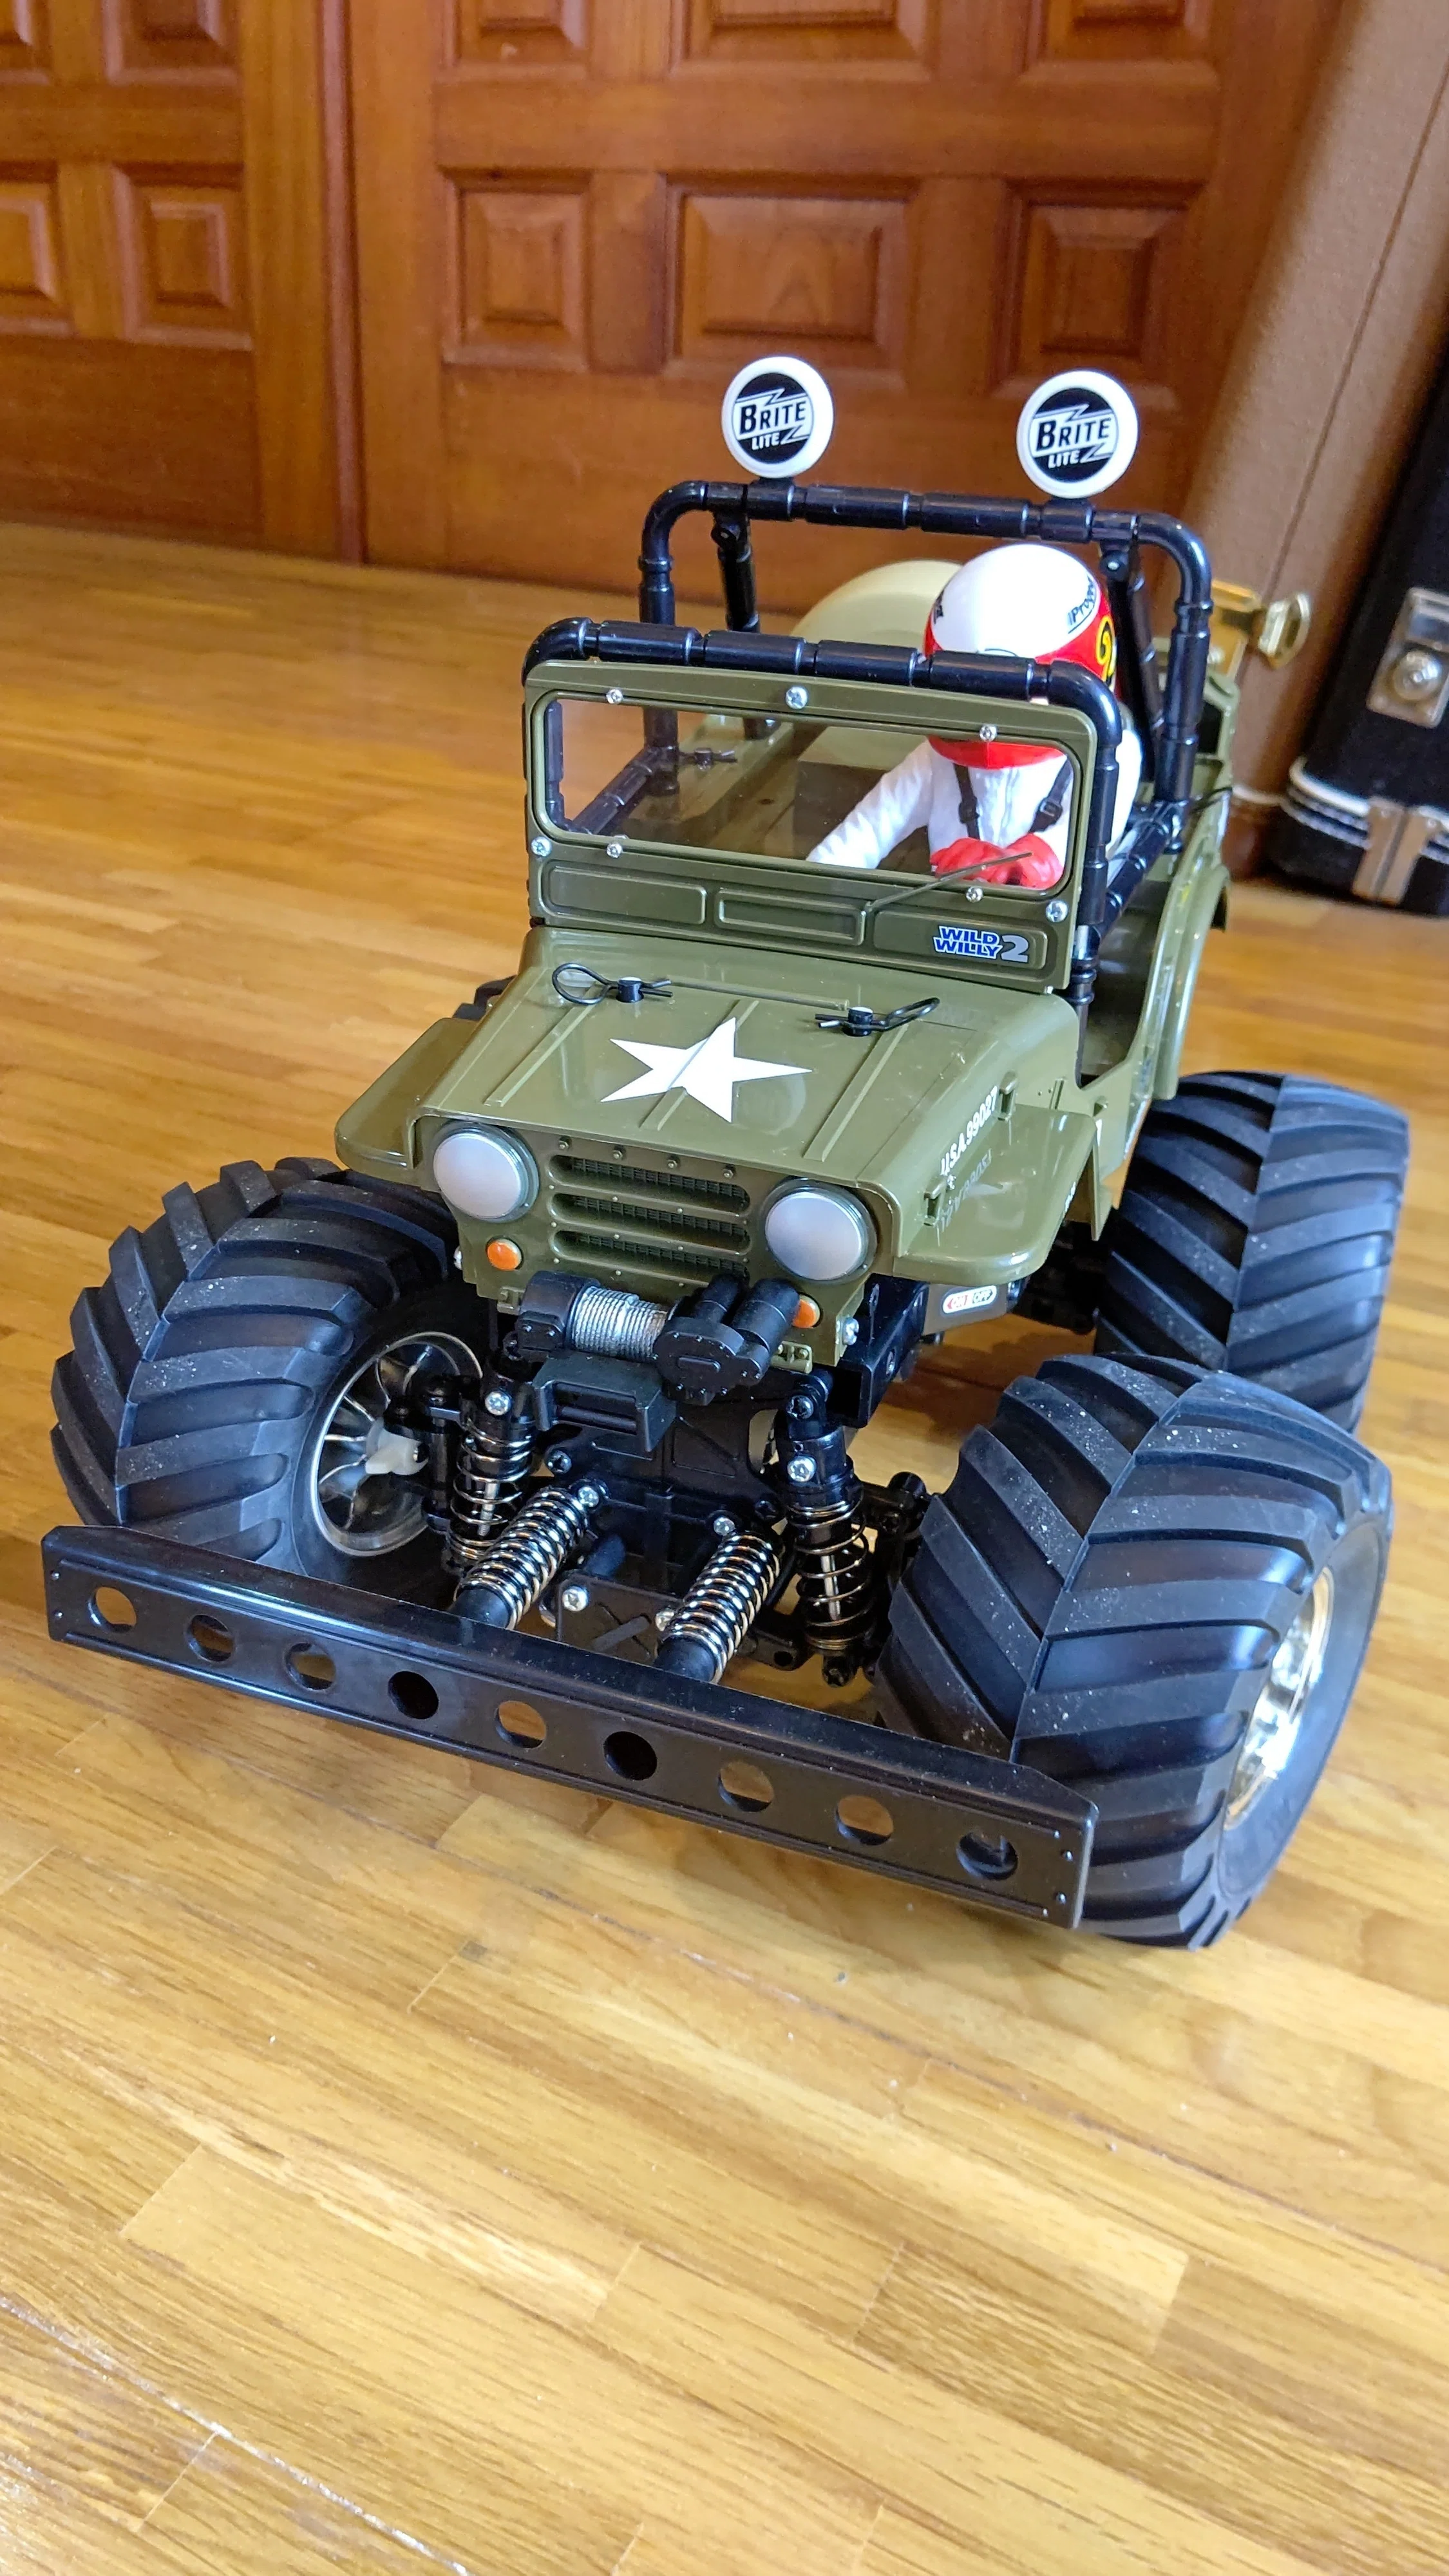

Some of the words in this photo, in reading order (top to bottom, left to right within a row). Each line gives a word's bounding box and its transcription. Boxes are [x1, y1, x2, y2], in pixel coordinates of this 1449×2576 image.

[740, 401, 806, 435] BRITE
[752, 432, 780, 450] LITE
[1036, 417, 1112, 451] BRITE
[1048, 450, 1080, 469] LITE
[939, 926, 999, 945] WILD
[934, 938, 1001, 958] WILLY
[1001, 935, 1028, 962] 2
